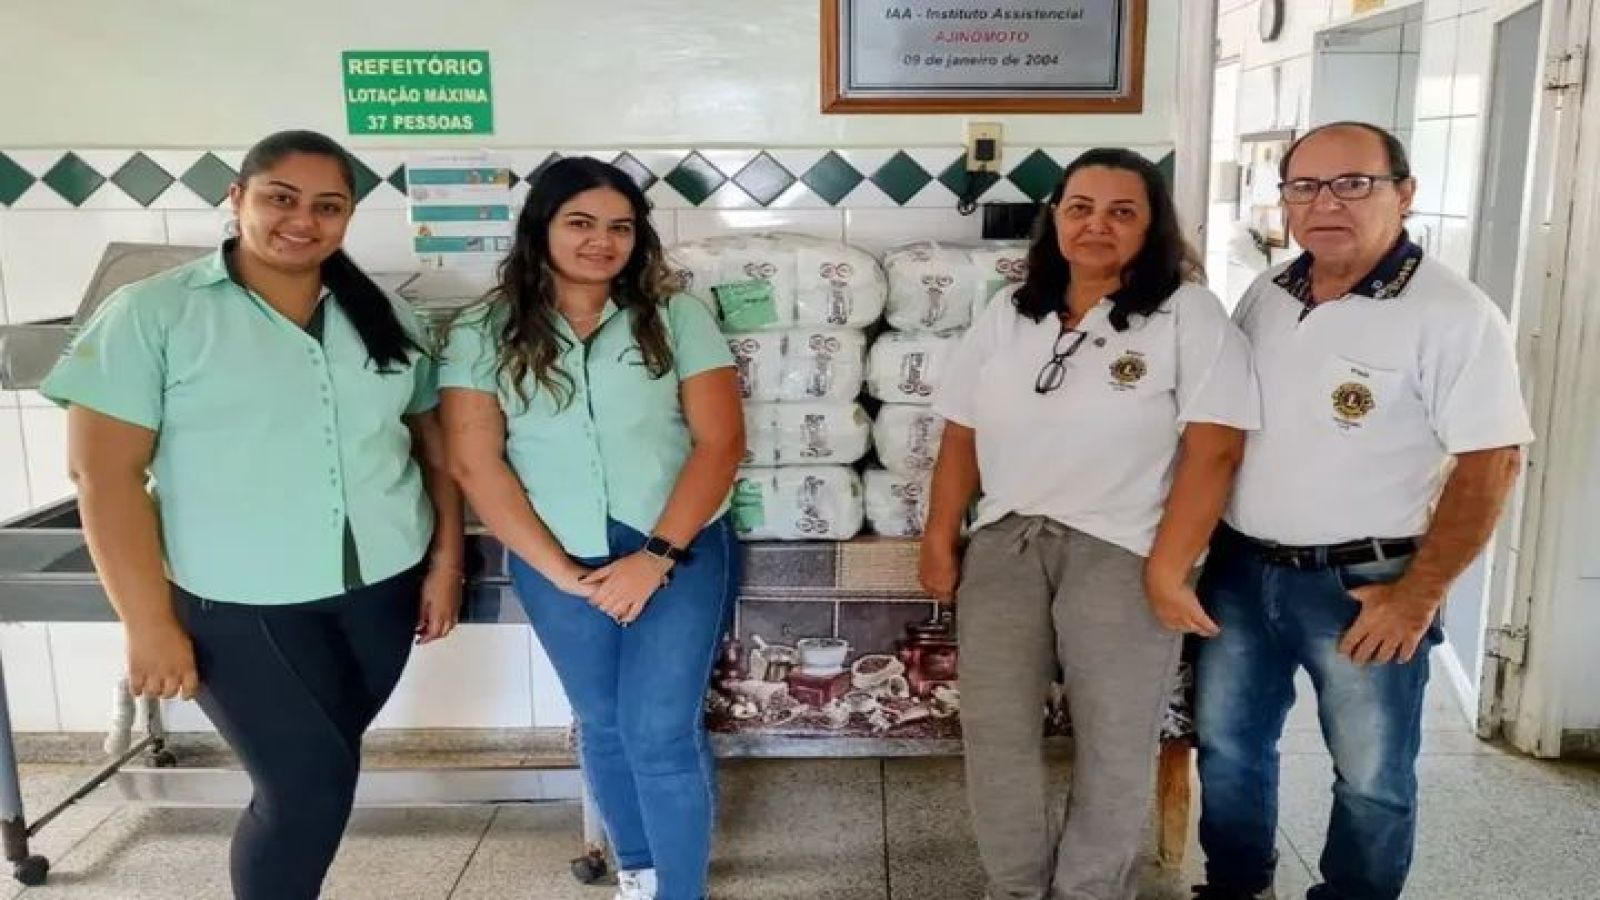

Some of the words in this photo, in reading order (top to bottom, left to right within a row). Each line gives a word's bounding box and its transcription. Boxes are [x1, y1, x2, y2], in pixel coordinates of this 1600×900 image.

[885, 8, 912, 20] IAA
[926, 7, 987, 20] Instituto
[991, 8, 1084, 20] Assistencial
[935, 30, 1030, 43] AJINOMOTO
[348, 54, 483, 75] REFEITÓRIO
[904, 54, 921, 66] 09
[924, 54, 943, 66] de
[944, 53, 998, 69] janeiro
[1002, 54, 1019, 66] de
[1024, 54, 1059, 66] 2004
[348, 85, 421, 107] LOTAÇÃO
[424, 85, 488, 103] MÁXIMA
[367, 115, 388, 130] 37
[392, 115, 474, 130] PESSOAS
